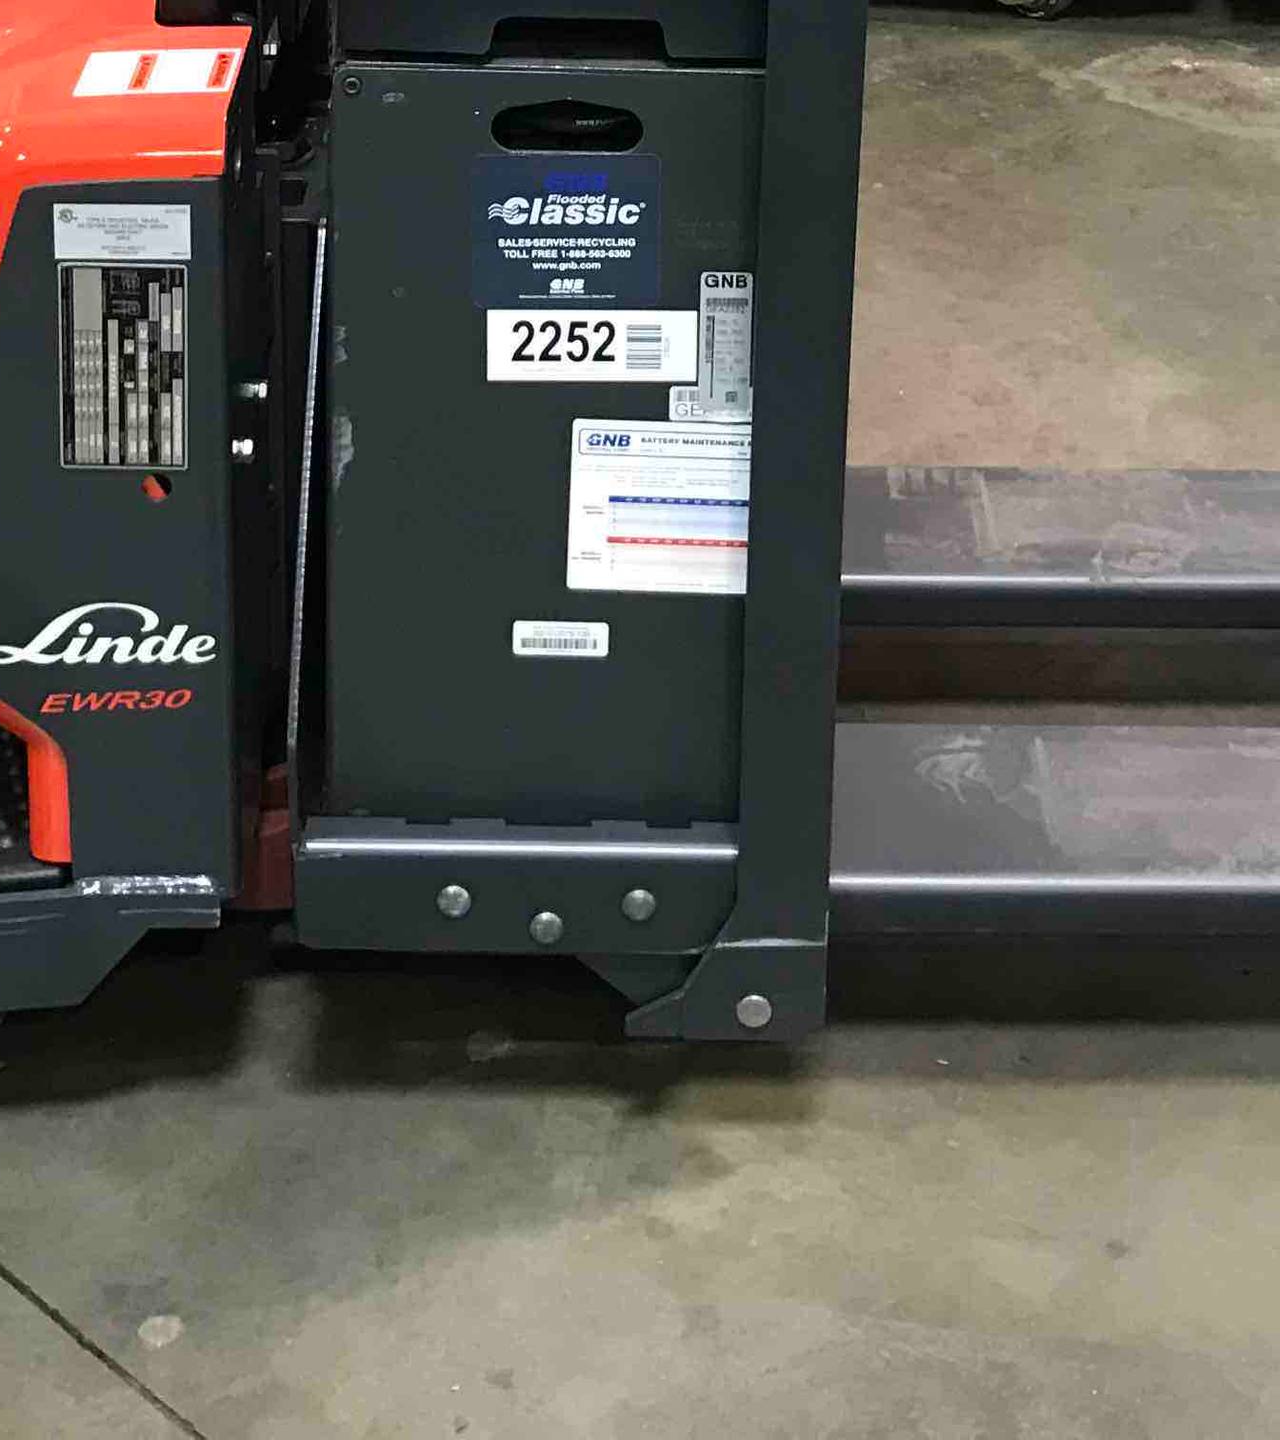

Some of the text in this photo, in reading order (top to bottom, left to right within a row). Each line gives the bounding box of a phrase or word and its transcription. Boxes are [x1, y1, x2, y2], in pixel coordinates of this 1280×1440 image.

[547, 193, 607, 205] Flooded
[495, 196, 642, 226] Classic
[503, 249, 529, 259] TOLL
[531, 249, 559, 259] FREE
[532, 261, 602, 271] www.gnb.com
[550, 278, 585, 290] GNB
[704, 274, 748, 289] GNB
[511, 320, 616, 362] 2252
[586, 433, 745, 448] GNB BATTERY MAINTENANCE
[39, 687, 193, 715] EWR30
